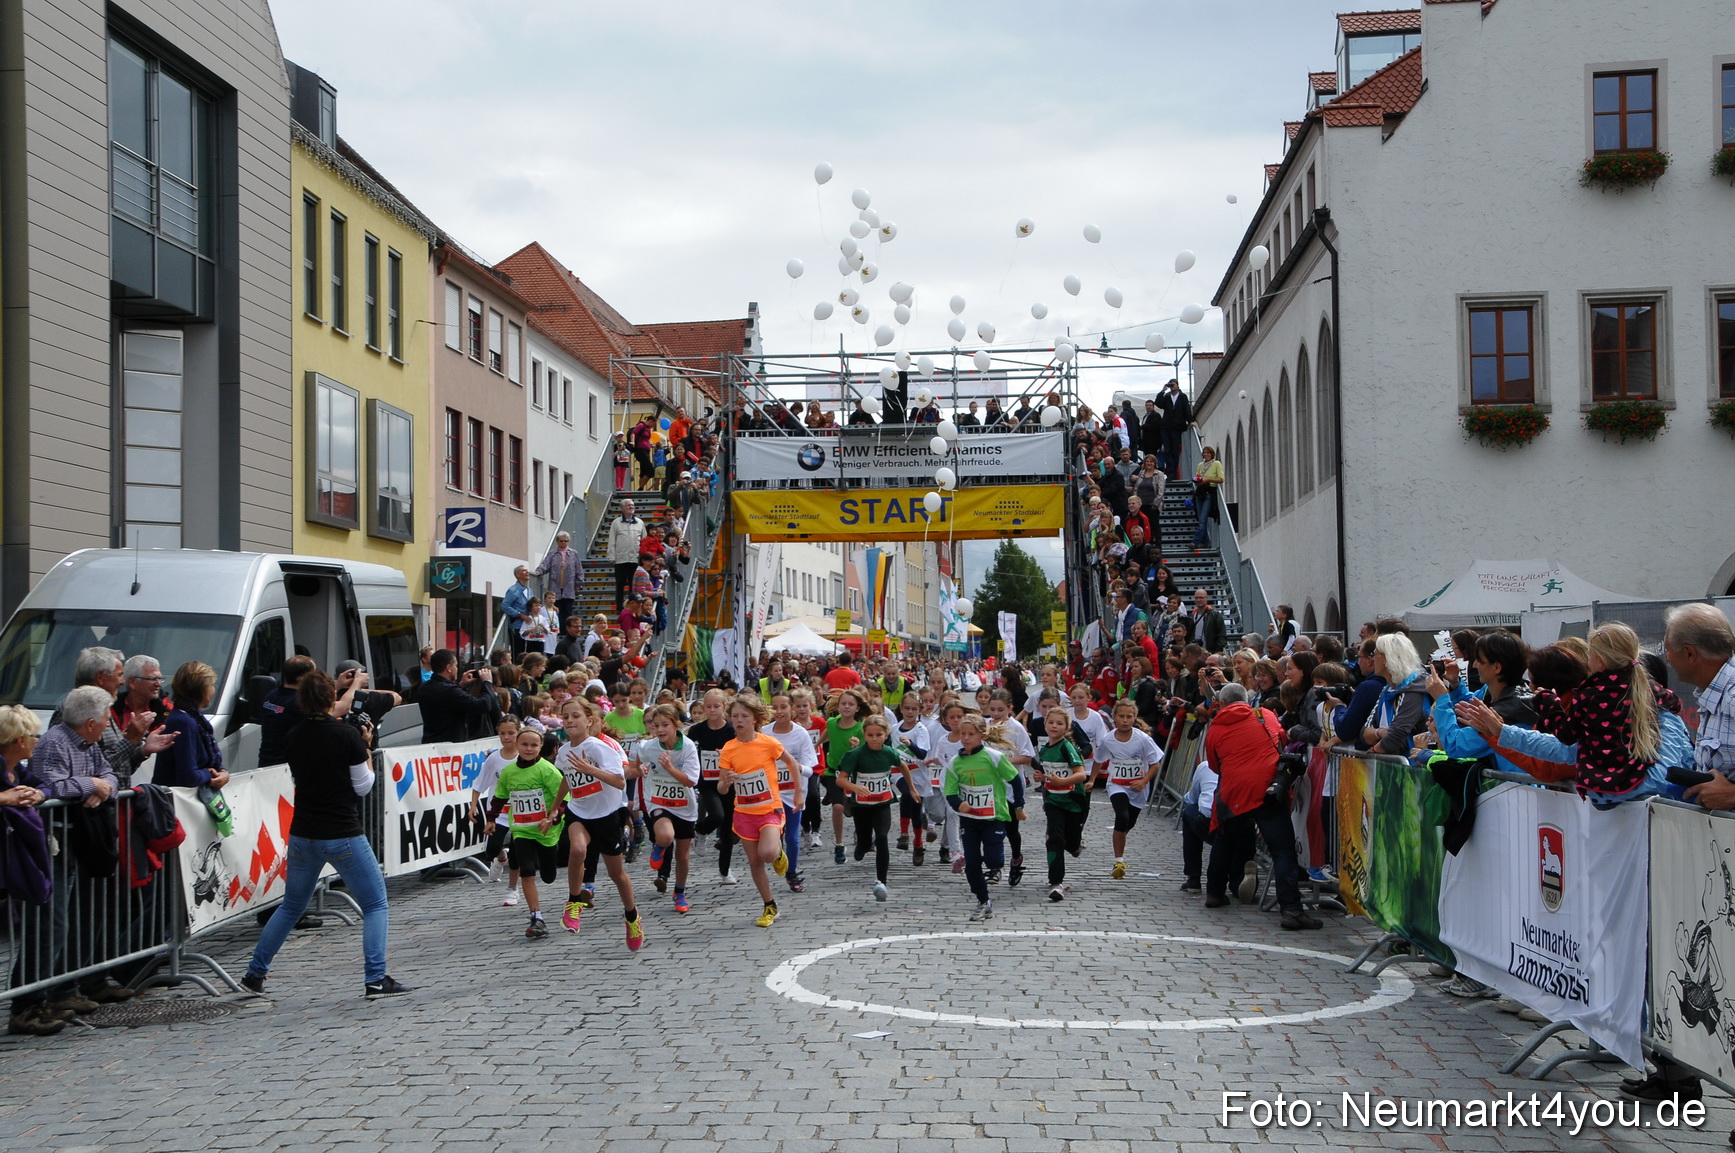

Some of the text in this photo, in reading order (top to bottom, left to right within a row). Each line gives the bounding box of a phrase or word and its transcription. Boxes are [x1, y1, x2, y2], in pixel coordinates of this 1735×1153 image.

[832, 444, 1002, 458] BMW Efficientynamics
[833, 460, 871, 469] Weniger
[872, 458, 922, 468] Verbrauch.
[924, 458, 948, 467] Mehr
[839, 497, 953, 525] START
[441, 566, 456, 584] G2
[1480, 580, 1526, 588] EINFACH
[755, 608, 764, 640] Audi
[891, 642, 898, 651] A
[1114, 766, 1141, 778] 7012
[654, 784, 685, 799] 7285
[736, 779, 765, 796] 7170
[513, 798, 541, 813] 7018
[400, 796, 488, 865] HACKN
[1545, 890, 1558, 905] 1628
